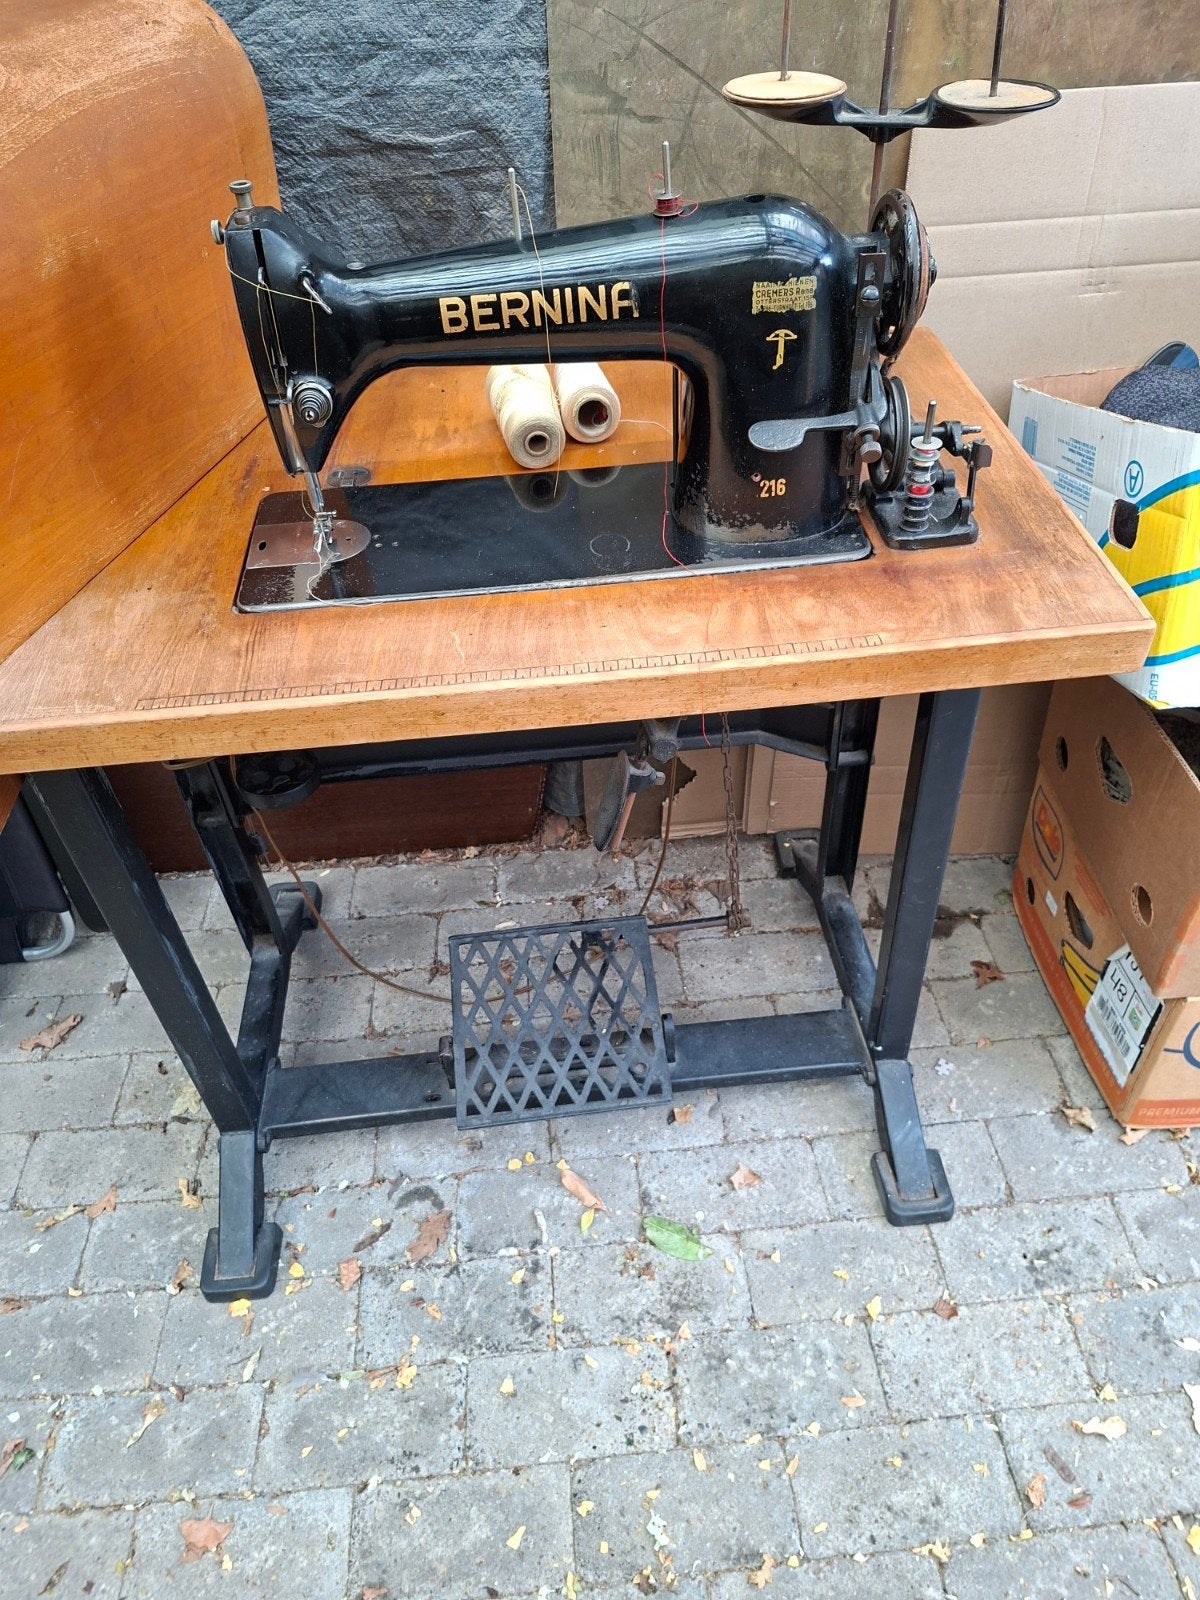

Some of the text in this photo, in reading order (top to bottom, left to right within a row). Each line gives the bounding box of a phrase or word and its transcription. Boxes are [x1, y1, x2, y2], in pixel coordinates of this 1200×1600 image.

[755, 287, 794, 299] CREMERS
[439, 281, 640, 334] BERNINA
[760, 478, 786, 498] 216
[1110, 968, 1128, 1002] 48
